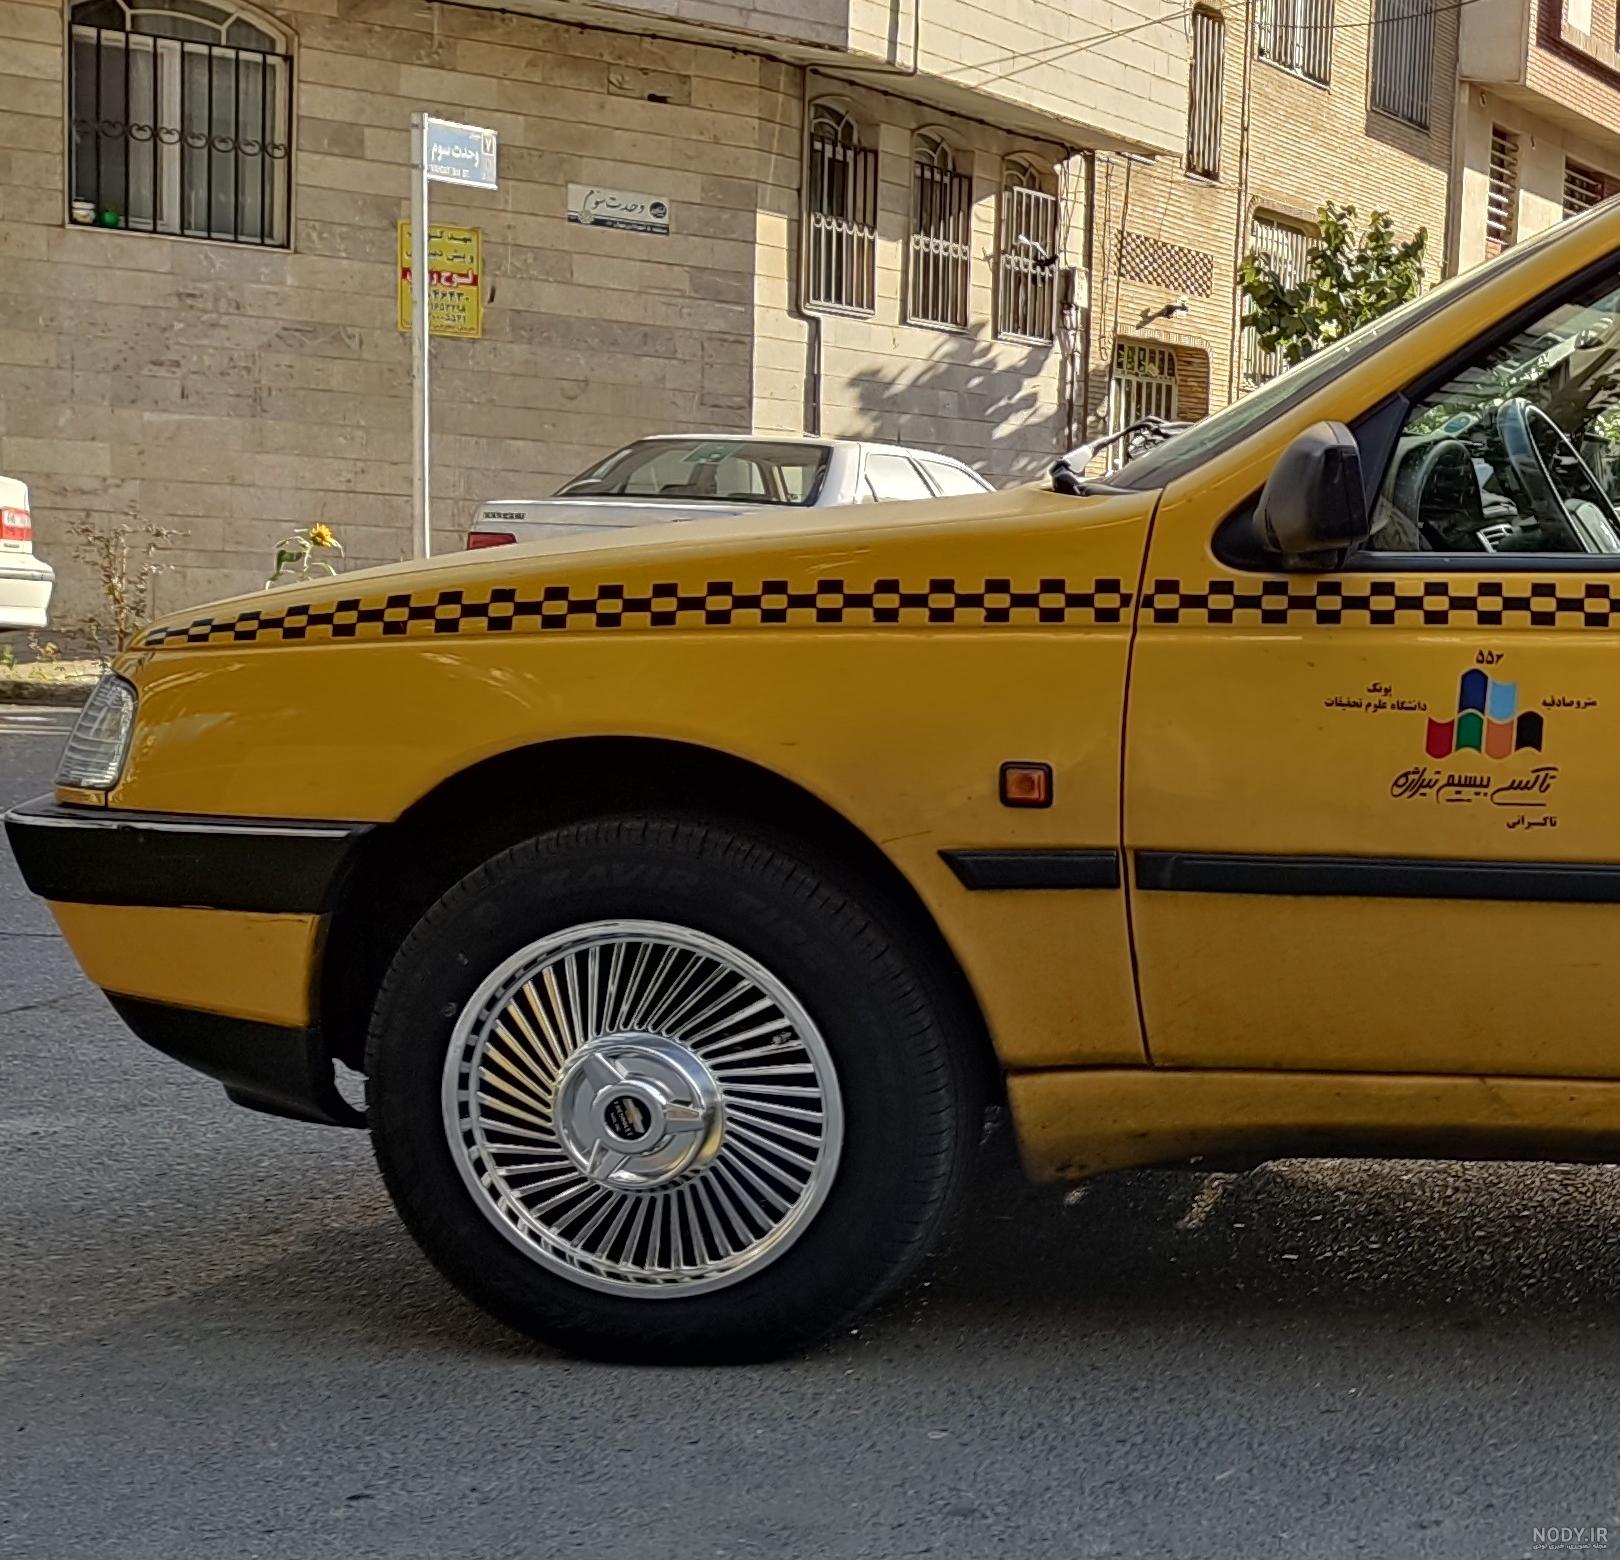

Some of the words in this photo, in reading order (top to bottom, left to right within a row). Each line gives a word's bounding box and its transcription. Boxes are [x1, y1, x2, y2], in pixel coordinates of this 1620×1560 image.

[431, 143, 451, 162] سوم
[451, 145, 480, 169] وحدت
[605, 196, 645, 214] وحدت
[1364, 699, 1388, 713] علوم
[1390, 699, 1428, 712] دانشگاه
